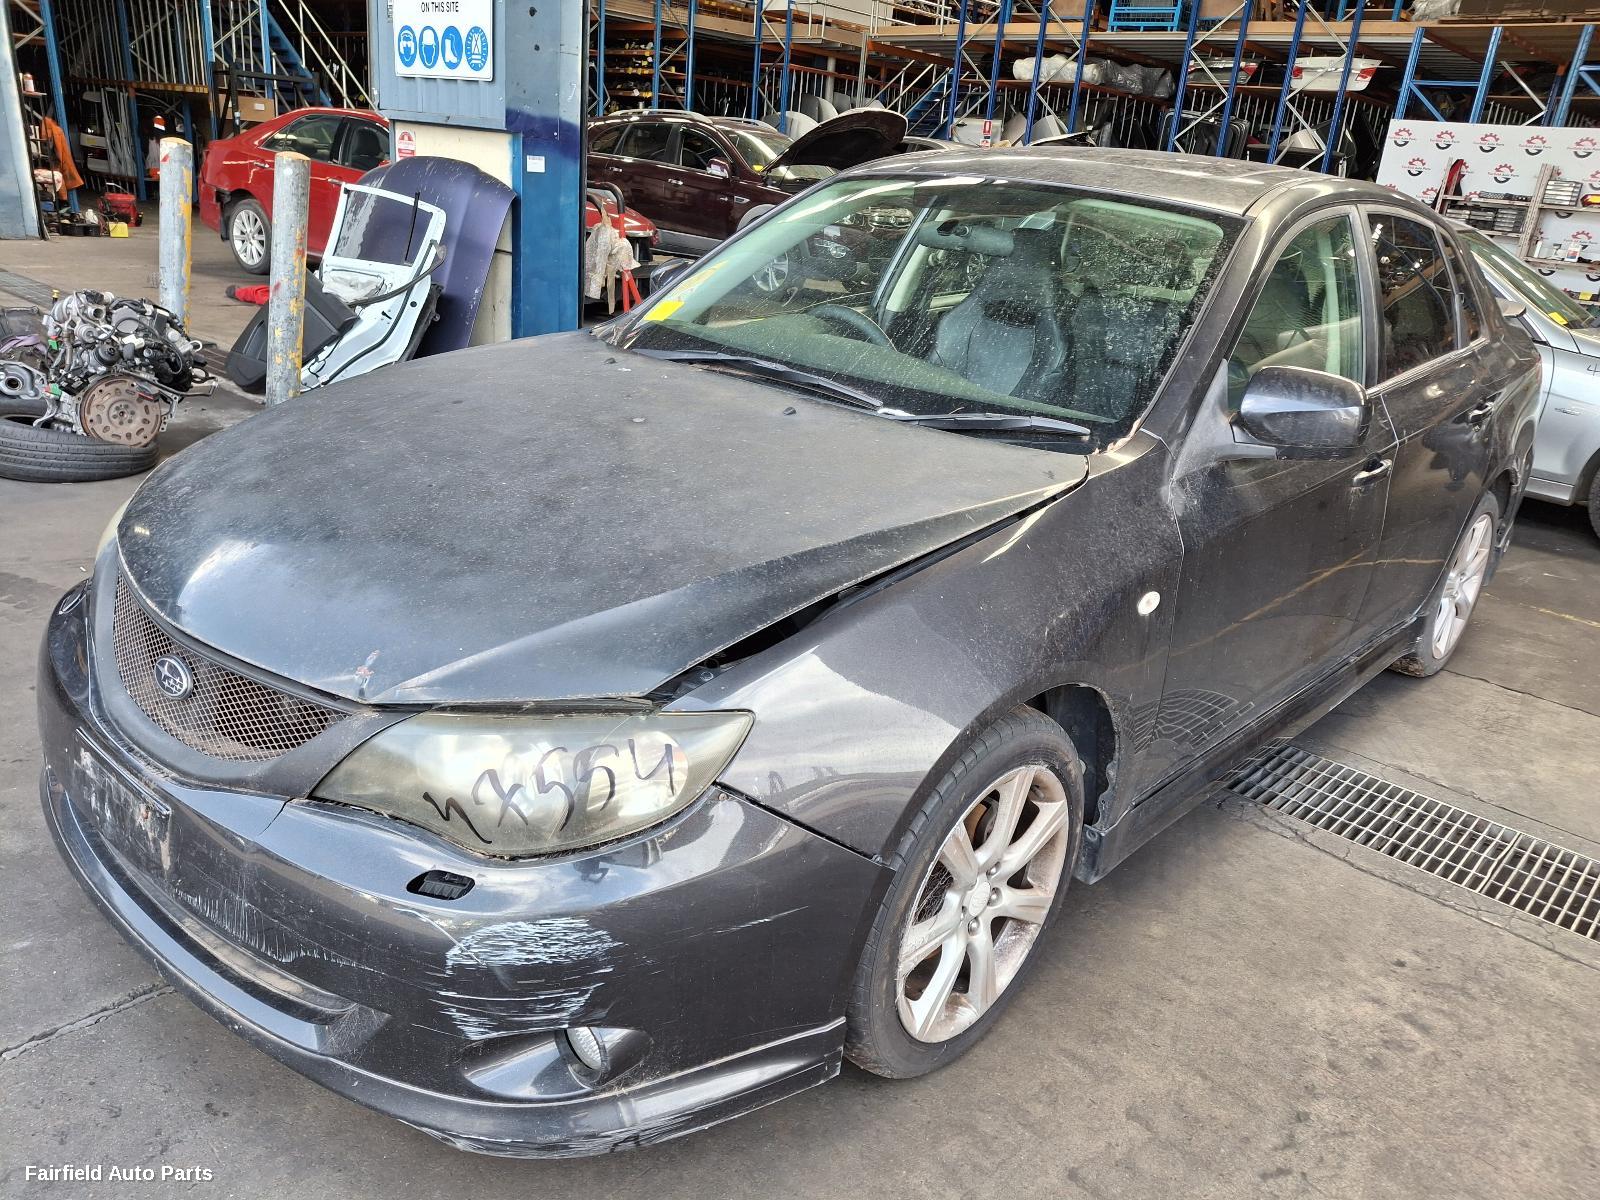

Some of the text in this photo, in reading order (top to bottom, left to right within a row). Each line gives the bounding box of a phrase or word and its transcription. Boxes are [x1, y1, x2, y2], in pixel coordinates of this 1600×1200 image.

[420, 2, 459, 12] ON THIS SITE
